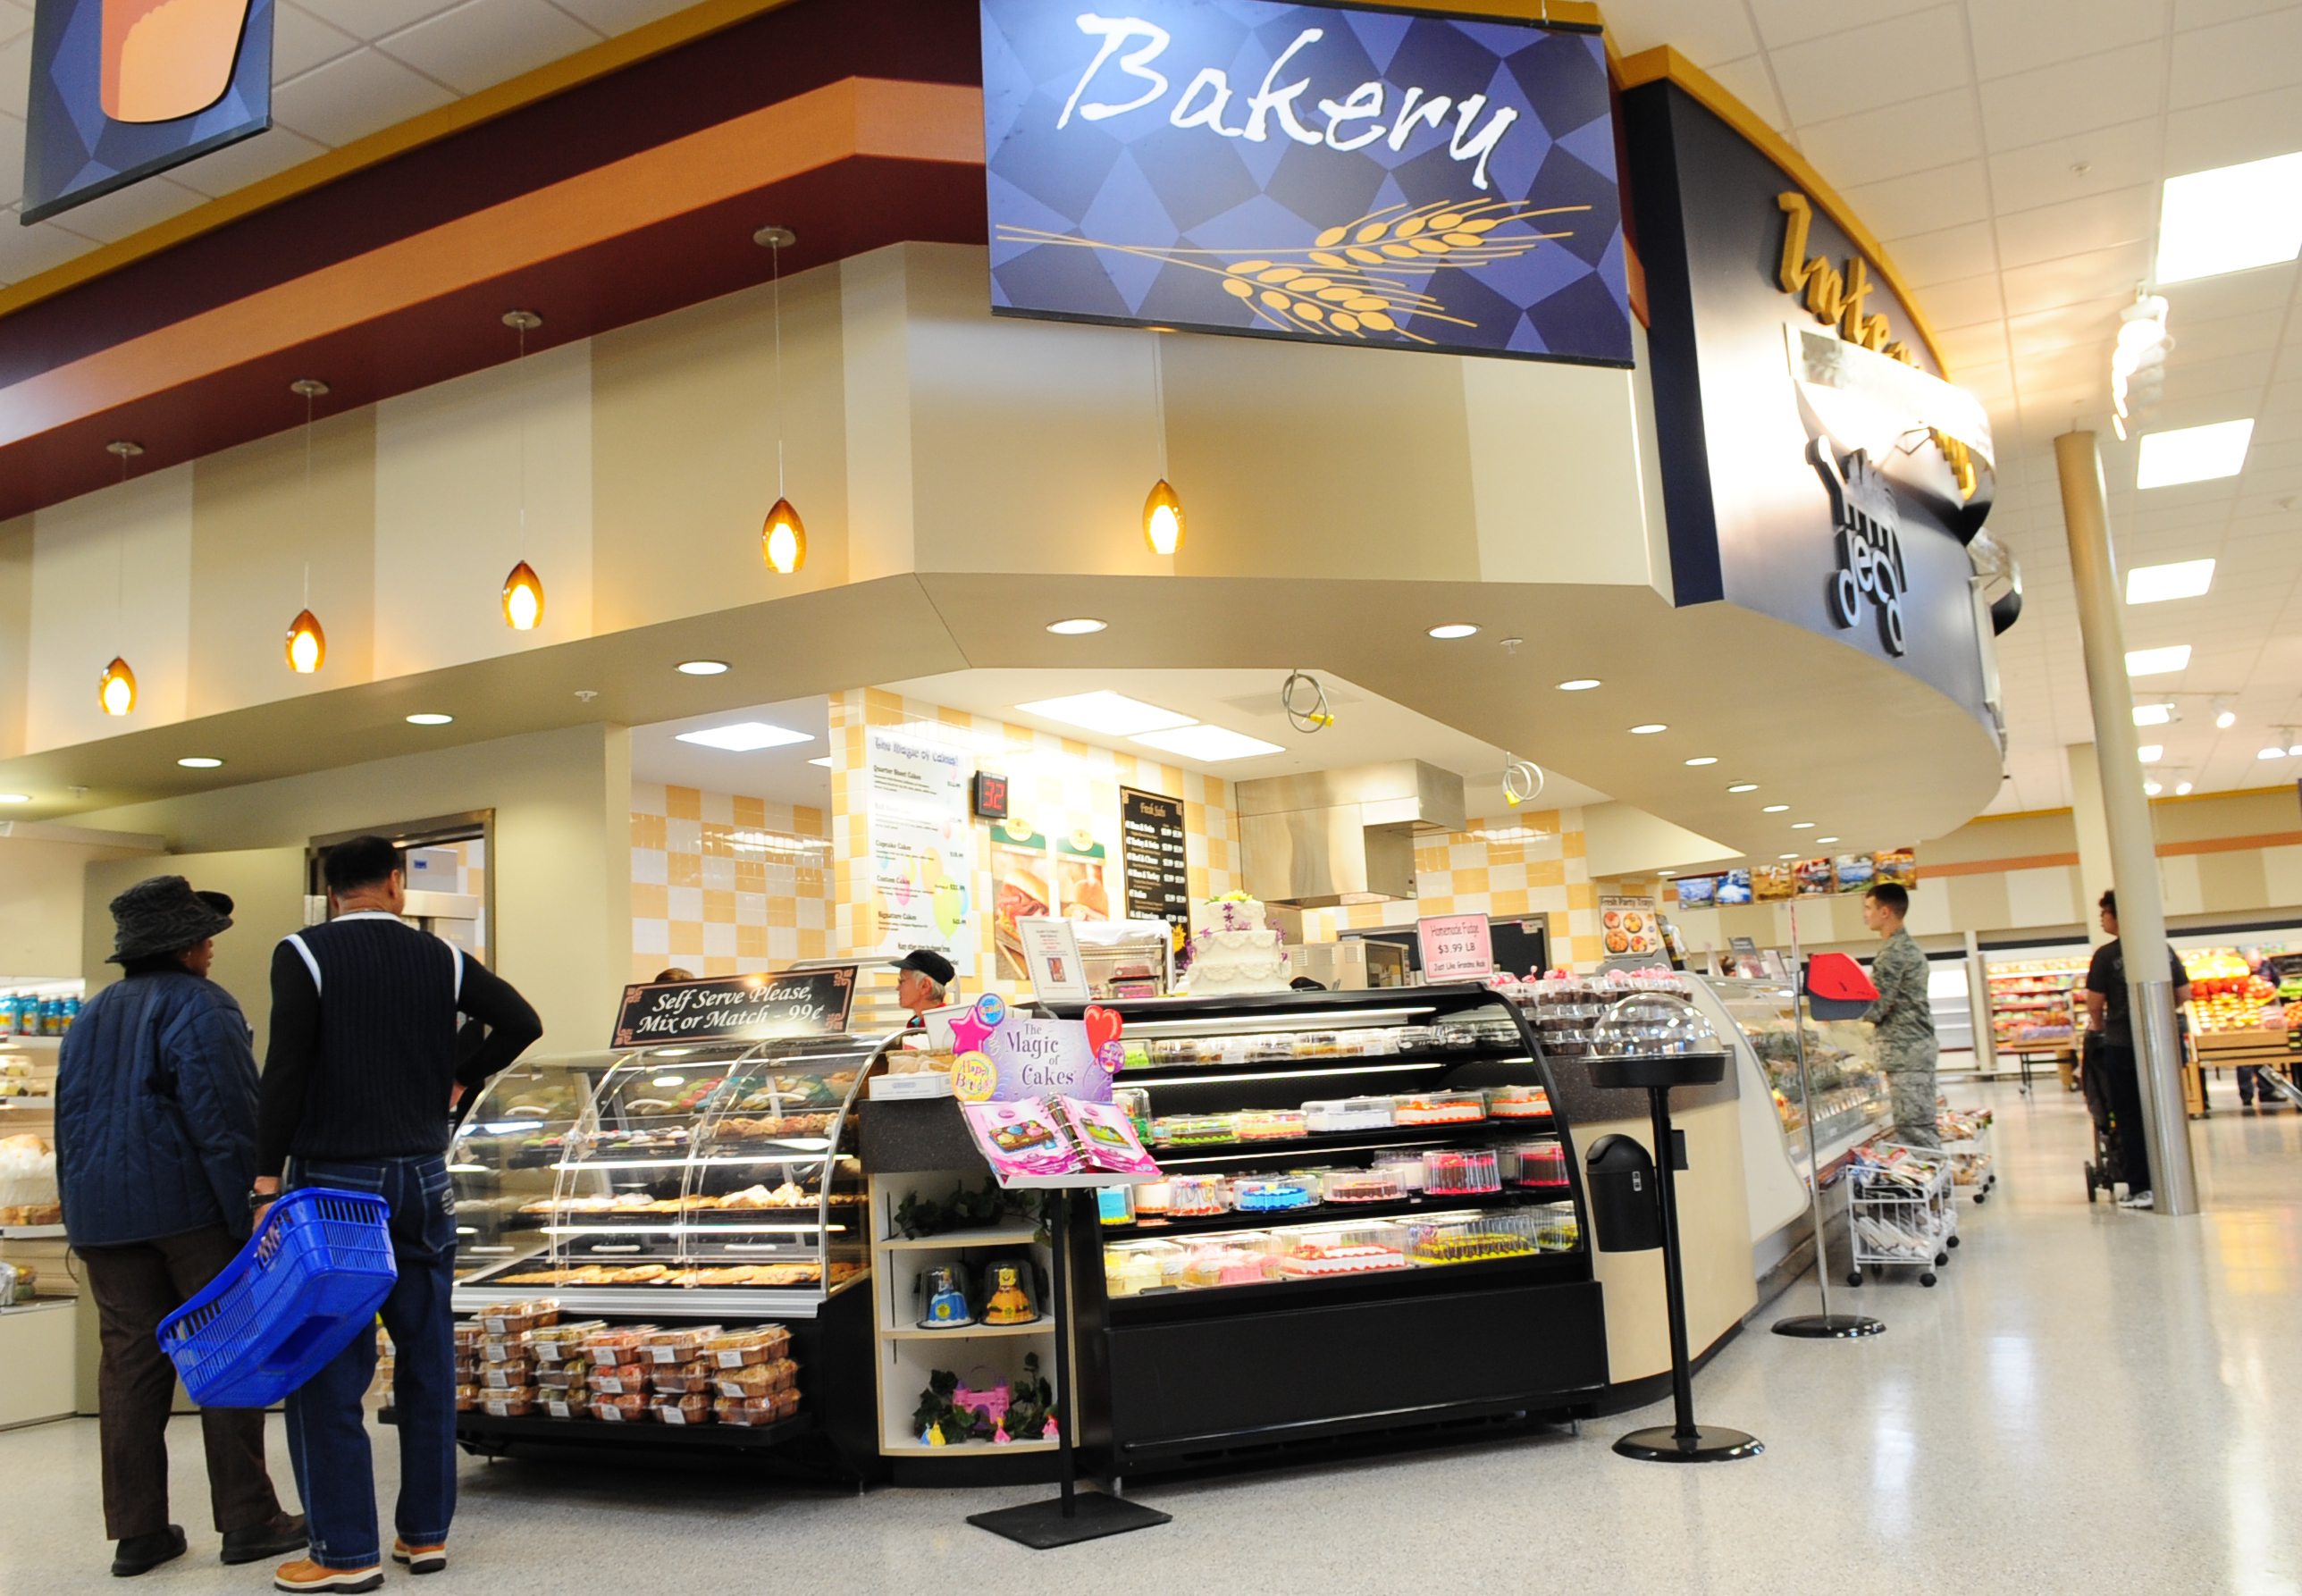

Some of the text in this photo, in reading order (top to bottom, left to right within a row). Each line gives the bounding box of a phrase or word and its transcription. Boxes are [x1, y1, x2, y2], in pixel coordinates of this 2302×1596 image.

[1056, 13, 1518, 189] Bakery
[983, 781, 1004, 810] 32
[1431, 921, 1479, 937] Homemade Fudge
[1438, 942, 1476, 954] $3.99 LB
[652, 982, 811, 1015] Self Serve Please,
[636, 1013, 678, 1035] Mix
[680, 1016, 701, 1029] or
[703, 1004, 771, 1029] Match
[788, 1003, 826, 1024] 99¢
[1024, 1023, 1042, 1035] The
[1005, 1031, 1059, 1059] Magic
[1049, 1054, 1060, 1066] of
[1022, 1063, 1074, 1087] Cakes
